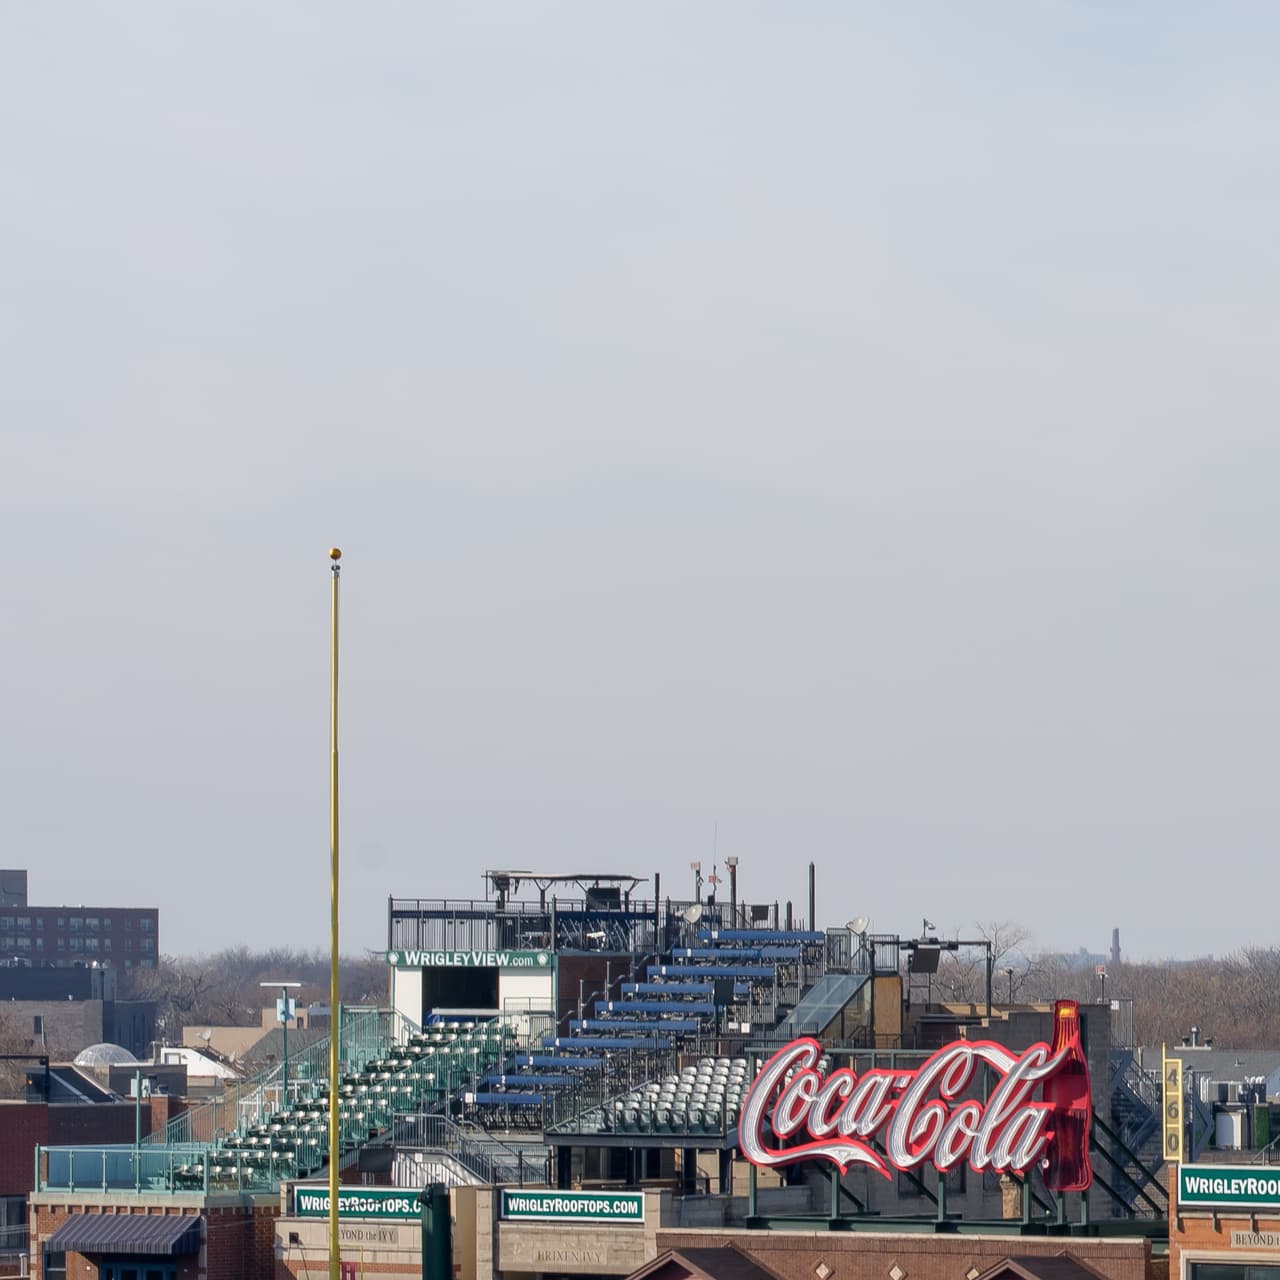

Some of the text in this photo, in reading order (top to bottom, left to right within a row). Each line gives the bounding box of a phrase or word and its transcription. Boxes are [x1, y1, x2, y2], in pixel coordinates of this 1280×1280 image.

[739, 1037, 1080, 1181] Coca-Cola
[1166, 1068, 1180, 1153] 460
[508, 1197, 638, 1214] WRIGLEYROOFTOPS.COM
[378, 1231, 394, 1241] IVY
[1235, 1233, 1274, 1246] BEYOND
[583, 1251, 601, 1263] IVY
